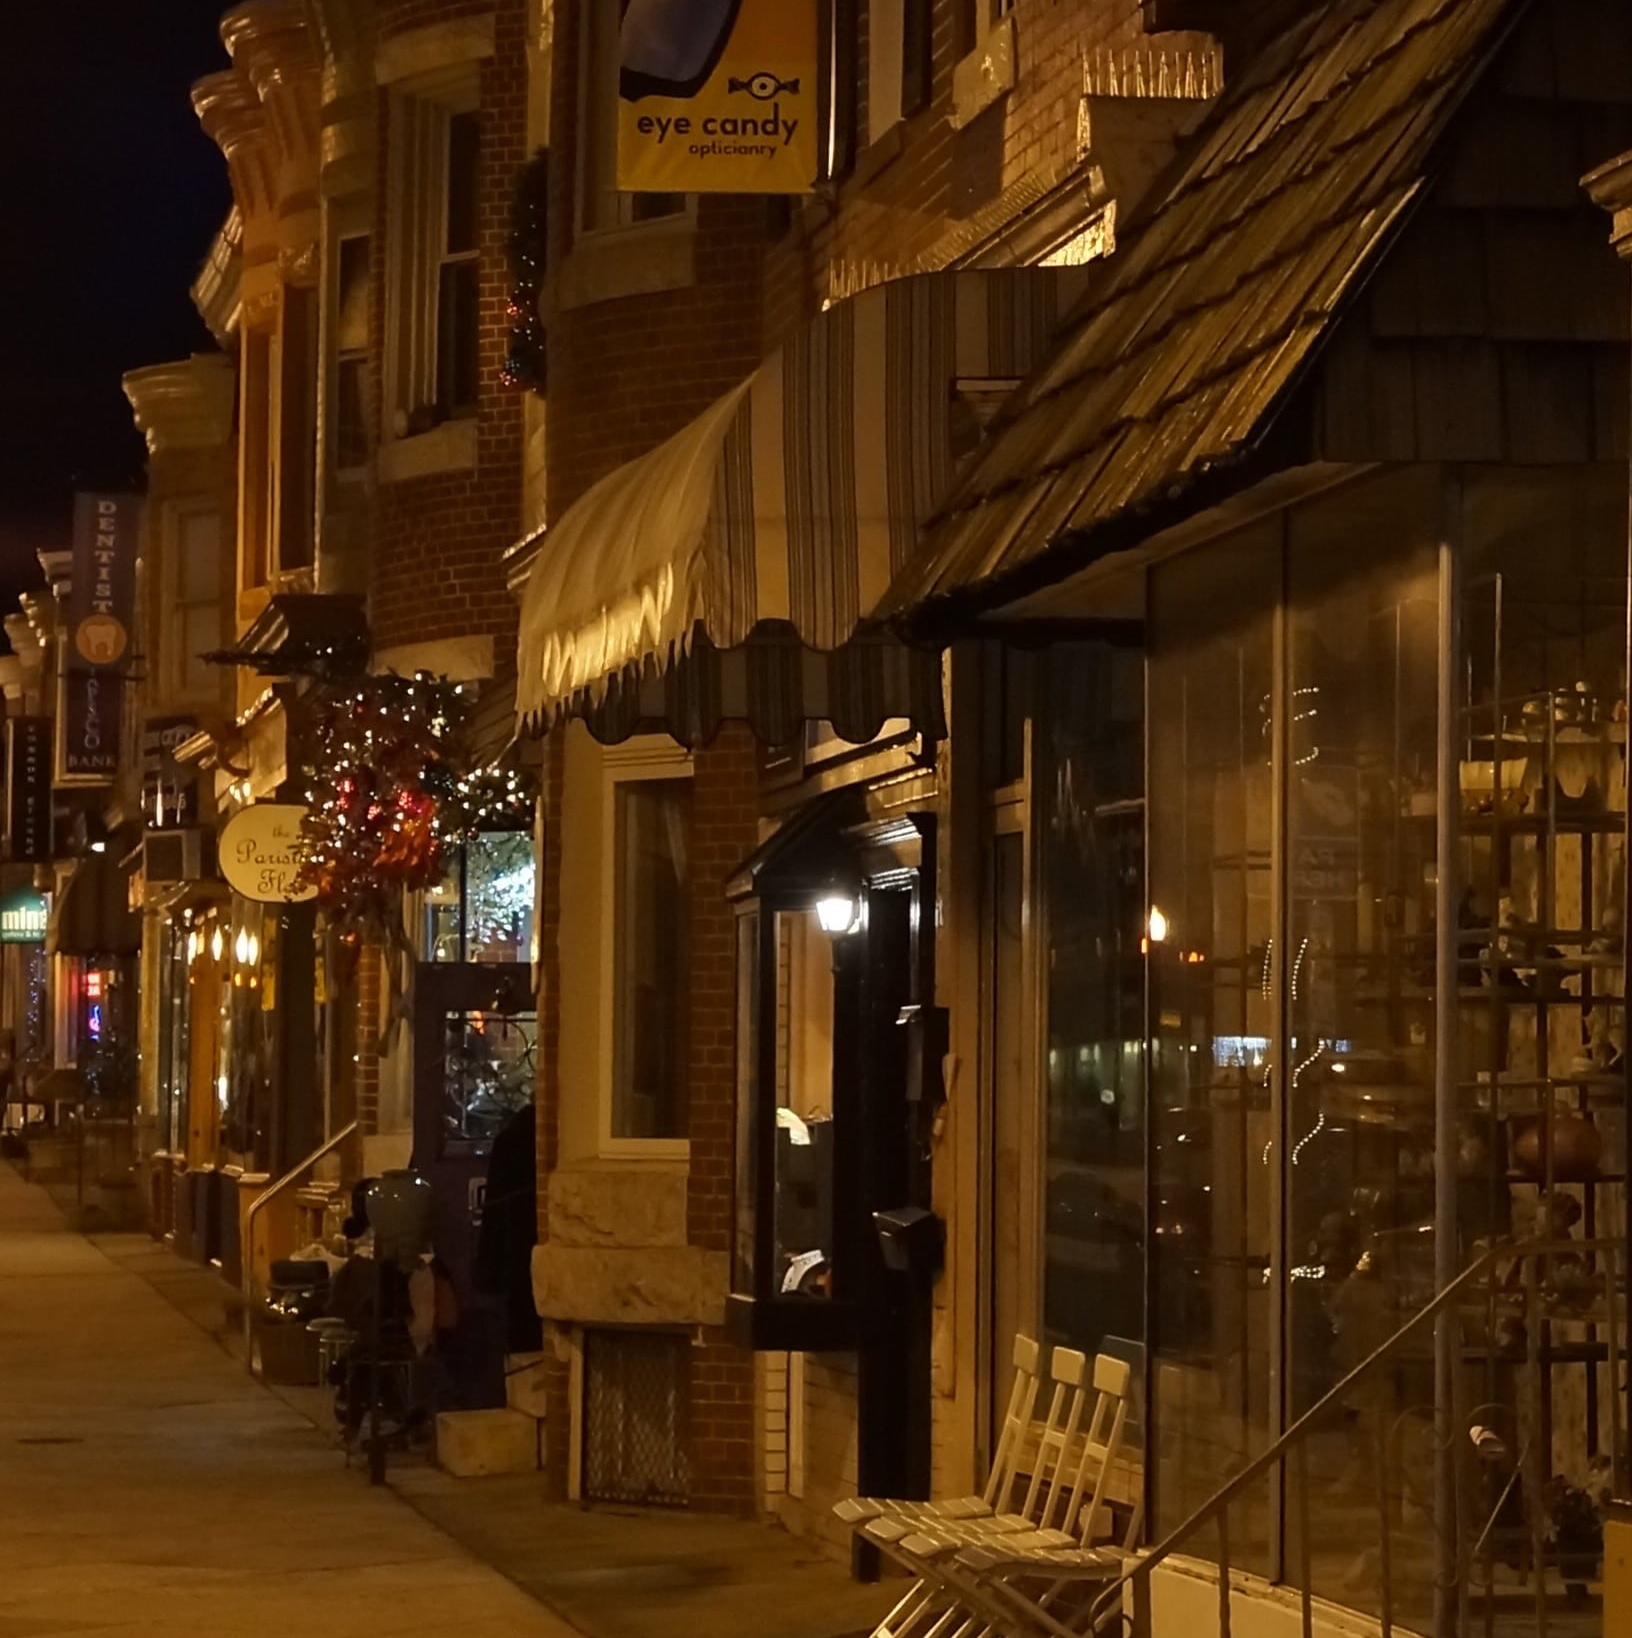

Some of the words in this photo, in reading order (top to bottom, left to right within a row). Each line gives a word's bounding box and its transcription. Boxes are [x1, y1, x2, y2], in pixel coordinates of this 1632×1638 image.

[637, 116, 691, 144] eye
[702, 102, 798, 146] candy
[688, 140, 777, 159] opticianry
[92, 500, 117, 614] DENTIST
